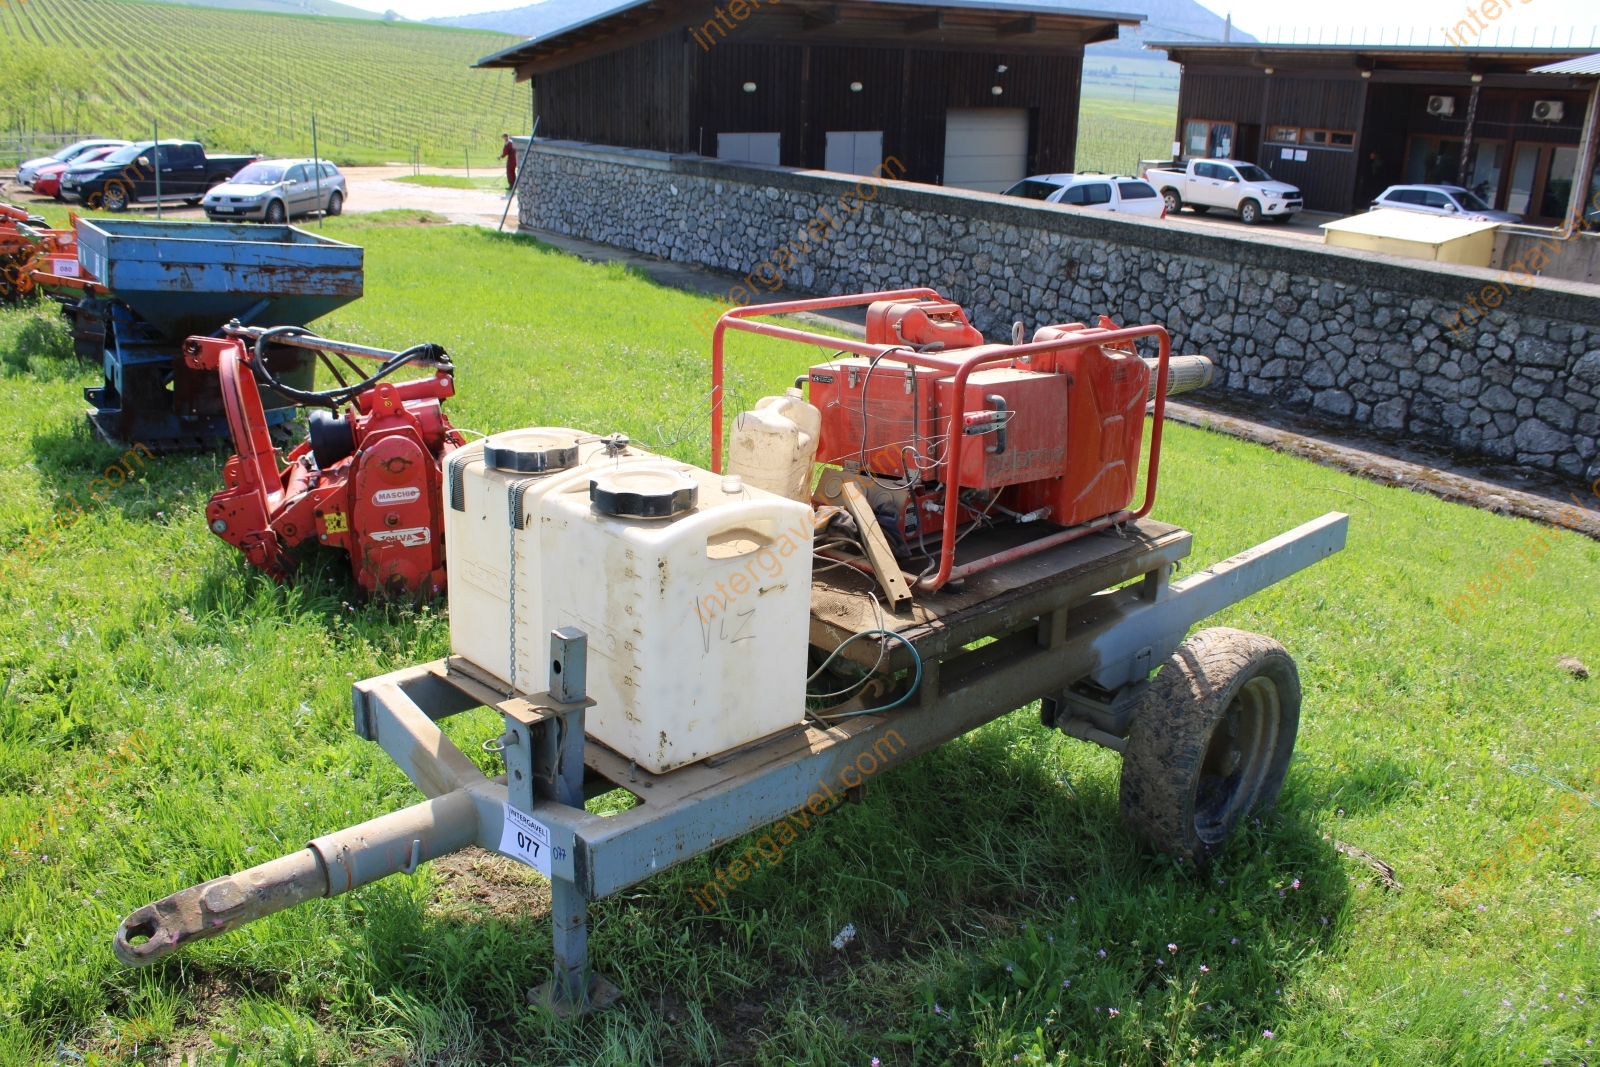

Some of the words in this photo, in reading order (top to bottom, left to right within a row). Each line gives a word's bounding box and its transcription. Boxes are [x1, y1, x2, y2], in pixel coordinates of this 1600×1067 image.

[378, 490, 416, 501] MASCHIO
[624, 675, 633, 687] 20
[510, 807, 546, 838] INTERGAVEL
[517, 831, 540, 858] 077
[552, 845, 567, 861] 077
